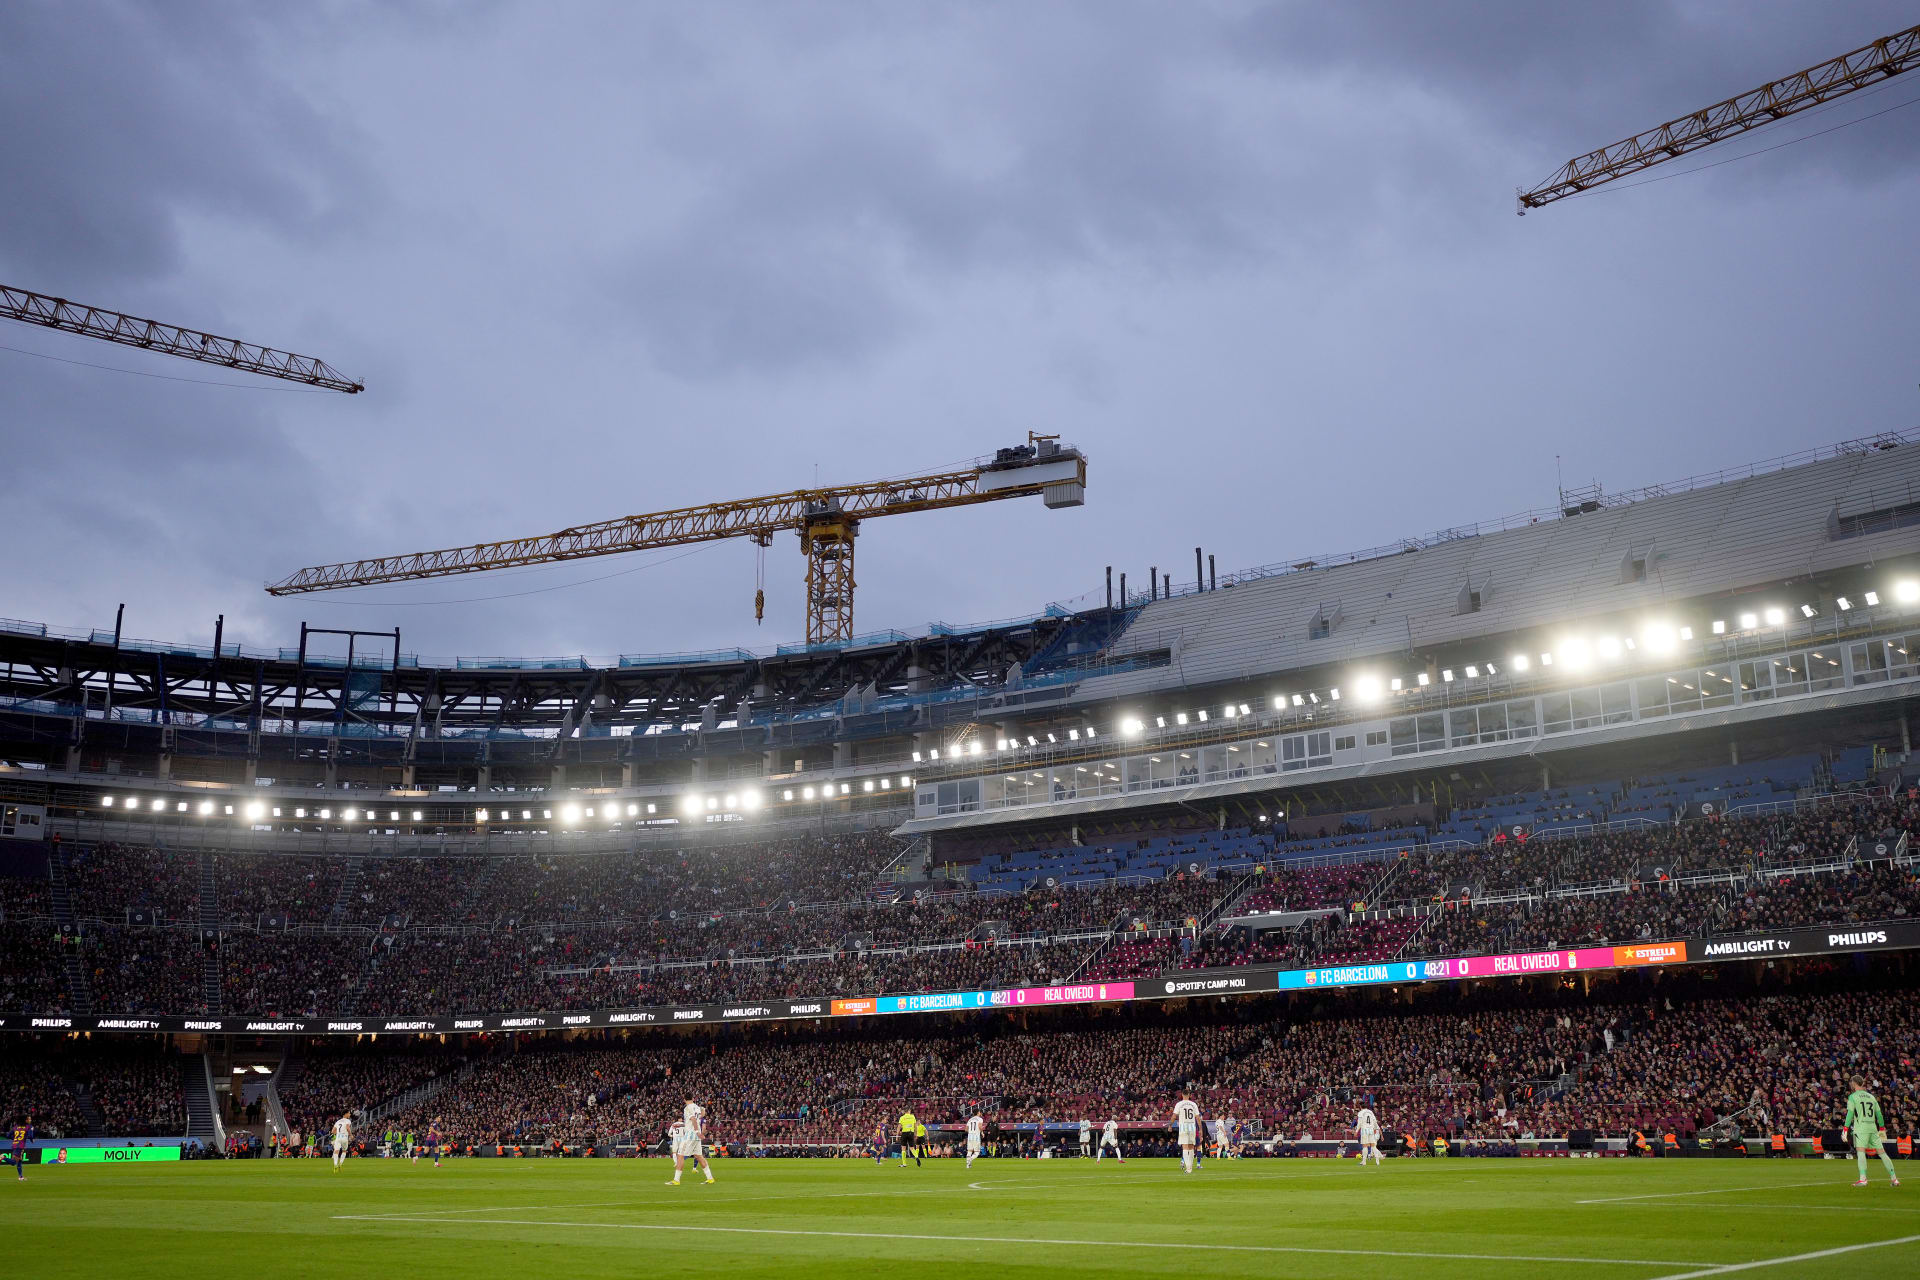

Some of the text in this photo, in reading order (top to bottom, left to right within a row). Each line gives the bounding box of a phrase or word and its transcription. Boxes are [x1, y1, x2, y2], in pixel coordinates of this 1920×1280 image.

[1829, 931, 1887, 946] PHILIPS
[1705, 940, 1790, 955] AMBILIGHT tv
[1635, 947, 1676, 958] ESTRELLA
[1494, 954, 1559, 971] REAL OVIEDO
[1321, 960, 1468, 983] FC BARCELONA 0 48:21 0
[1176, 979, 1245, 991] SPOTIFY CAMP NOU
[1044, 987, 1093, 1000] REAL OVIEDO
[910, 990, 1024, 1008] FC BARCELONA 0 48:21 0
[723, 1008, 770, 1017] AMBILIGHT tv
[790, 1004, 821, 1014] PHILIPS
[563, 1016, 591, 1024] PHILIPS
[609, 1013, 655, 1022] AMBILIGHT tv
[674, 1011, 703, 1020] PHILIPS
[32, 1019, 72, 1027] PHILIPS
[98, 1020, 160, 1029] AMBILIGHT tv
[185, 1021, 222, 1029] PHILIPS
[246, 1022, 294, 1030] AMBILIGHT
[328, 1022, 362, 1030] PHILIPS
[454, 1020, 484, 1028] PHILIPS
[501, 1018, 538, 1027] AMBILIGHT
[1183, 1108, 1193, 1120] 16
[1860, 1101, 1874, 1118] 13
[1366, 1115, 1371, 1124] 4
[14, 1130, 25, 1141] 23
[104, 1151, 142, 1160] MOLIY
